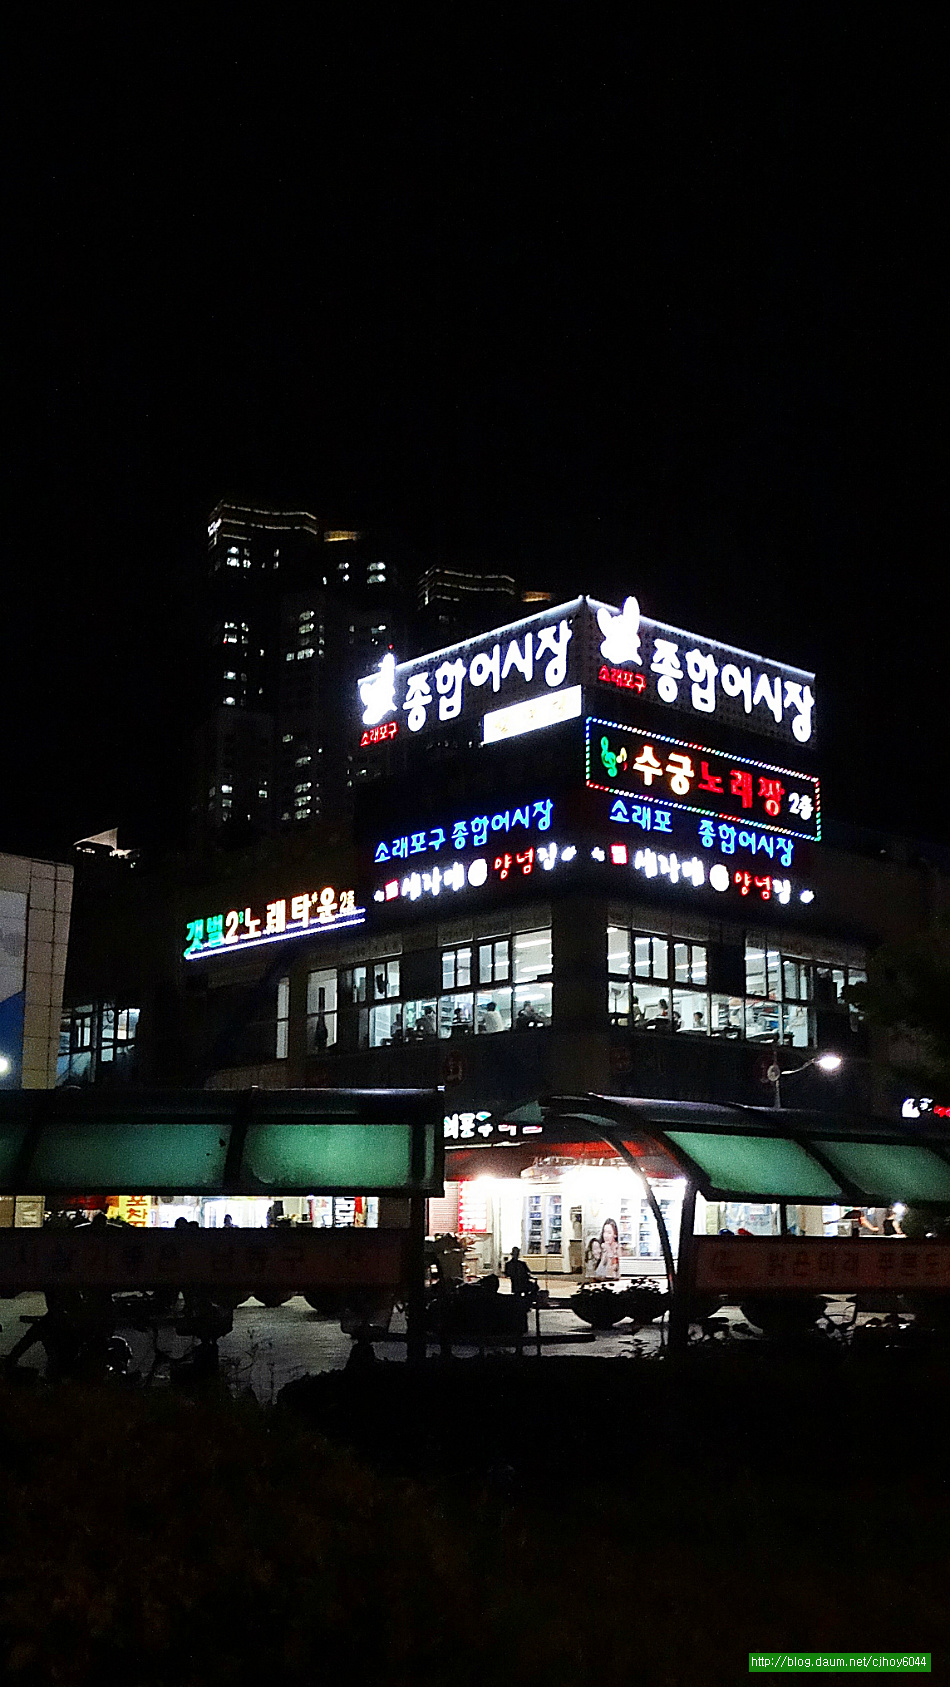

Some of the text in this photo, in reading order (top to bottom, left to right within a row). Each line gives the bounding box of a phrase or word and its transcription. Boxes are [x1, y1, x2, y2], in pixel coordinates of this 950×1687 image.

[402, 619, 573, 732] 종합어시장
[599, 664, 647, 695] 소래포구
[650, 638, 815, 743] 종합어시장
[360, 721, 399, 747] 소래포구
[633, 745, 695, 795] 수궁
[374, 798, 554, 863] 소래포구 종합어시장
[609, 799, 794, 867] 소래포 종합어시장
